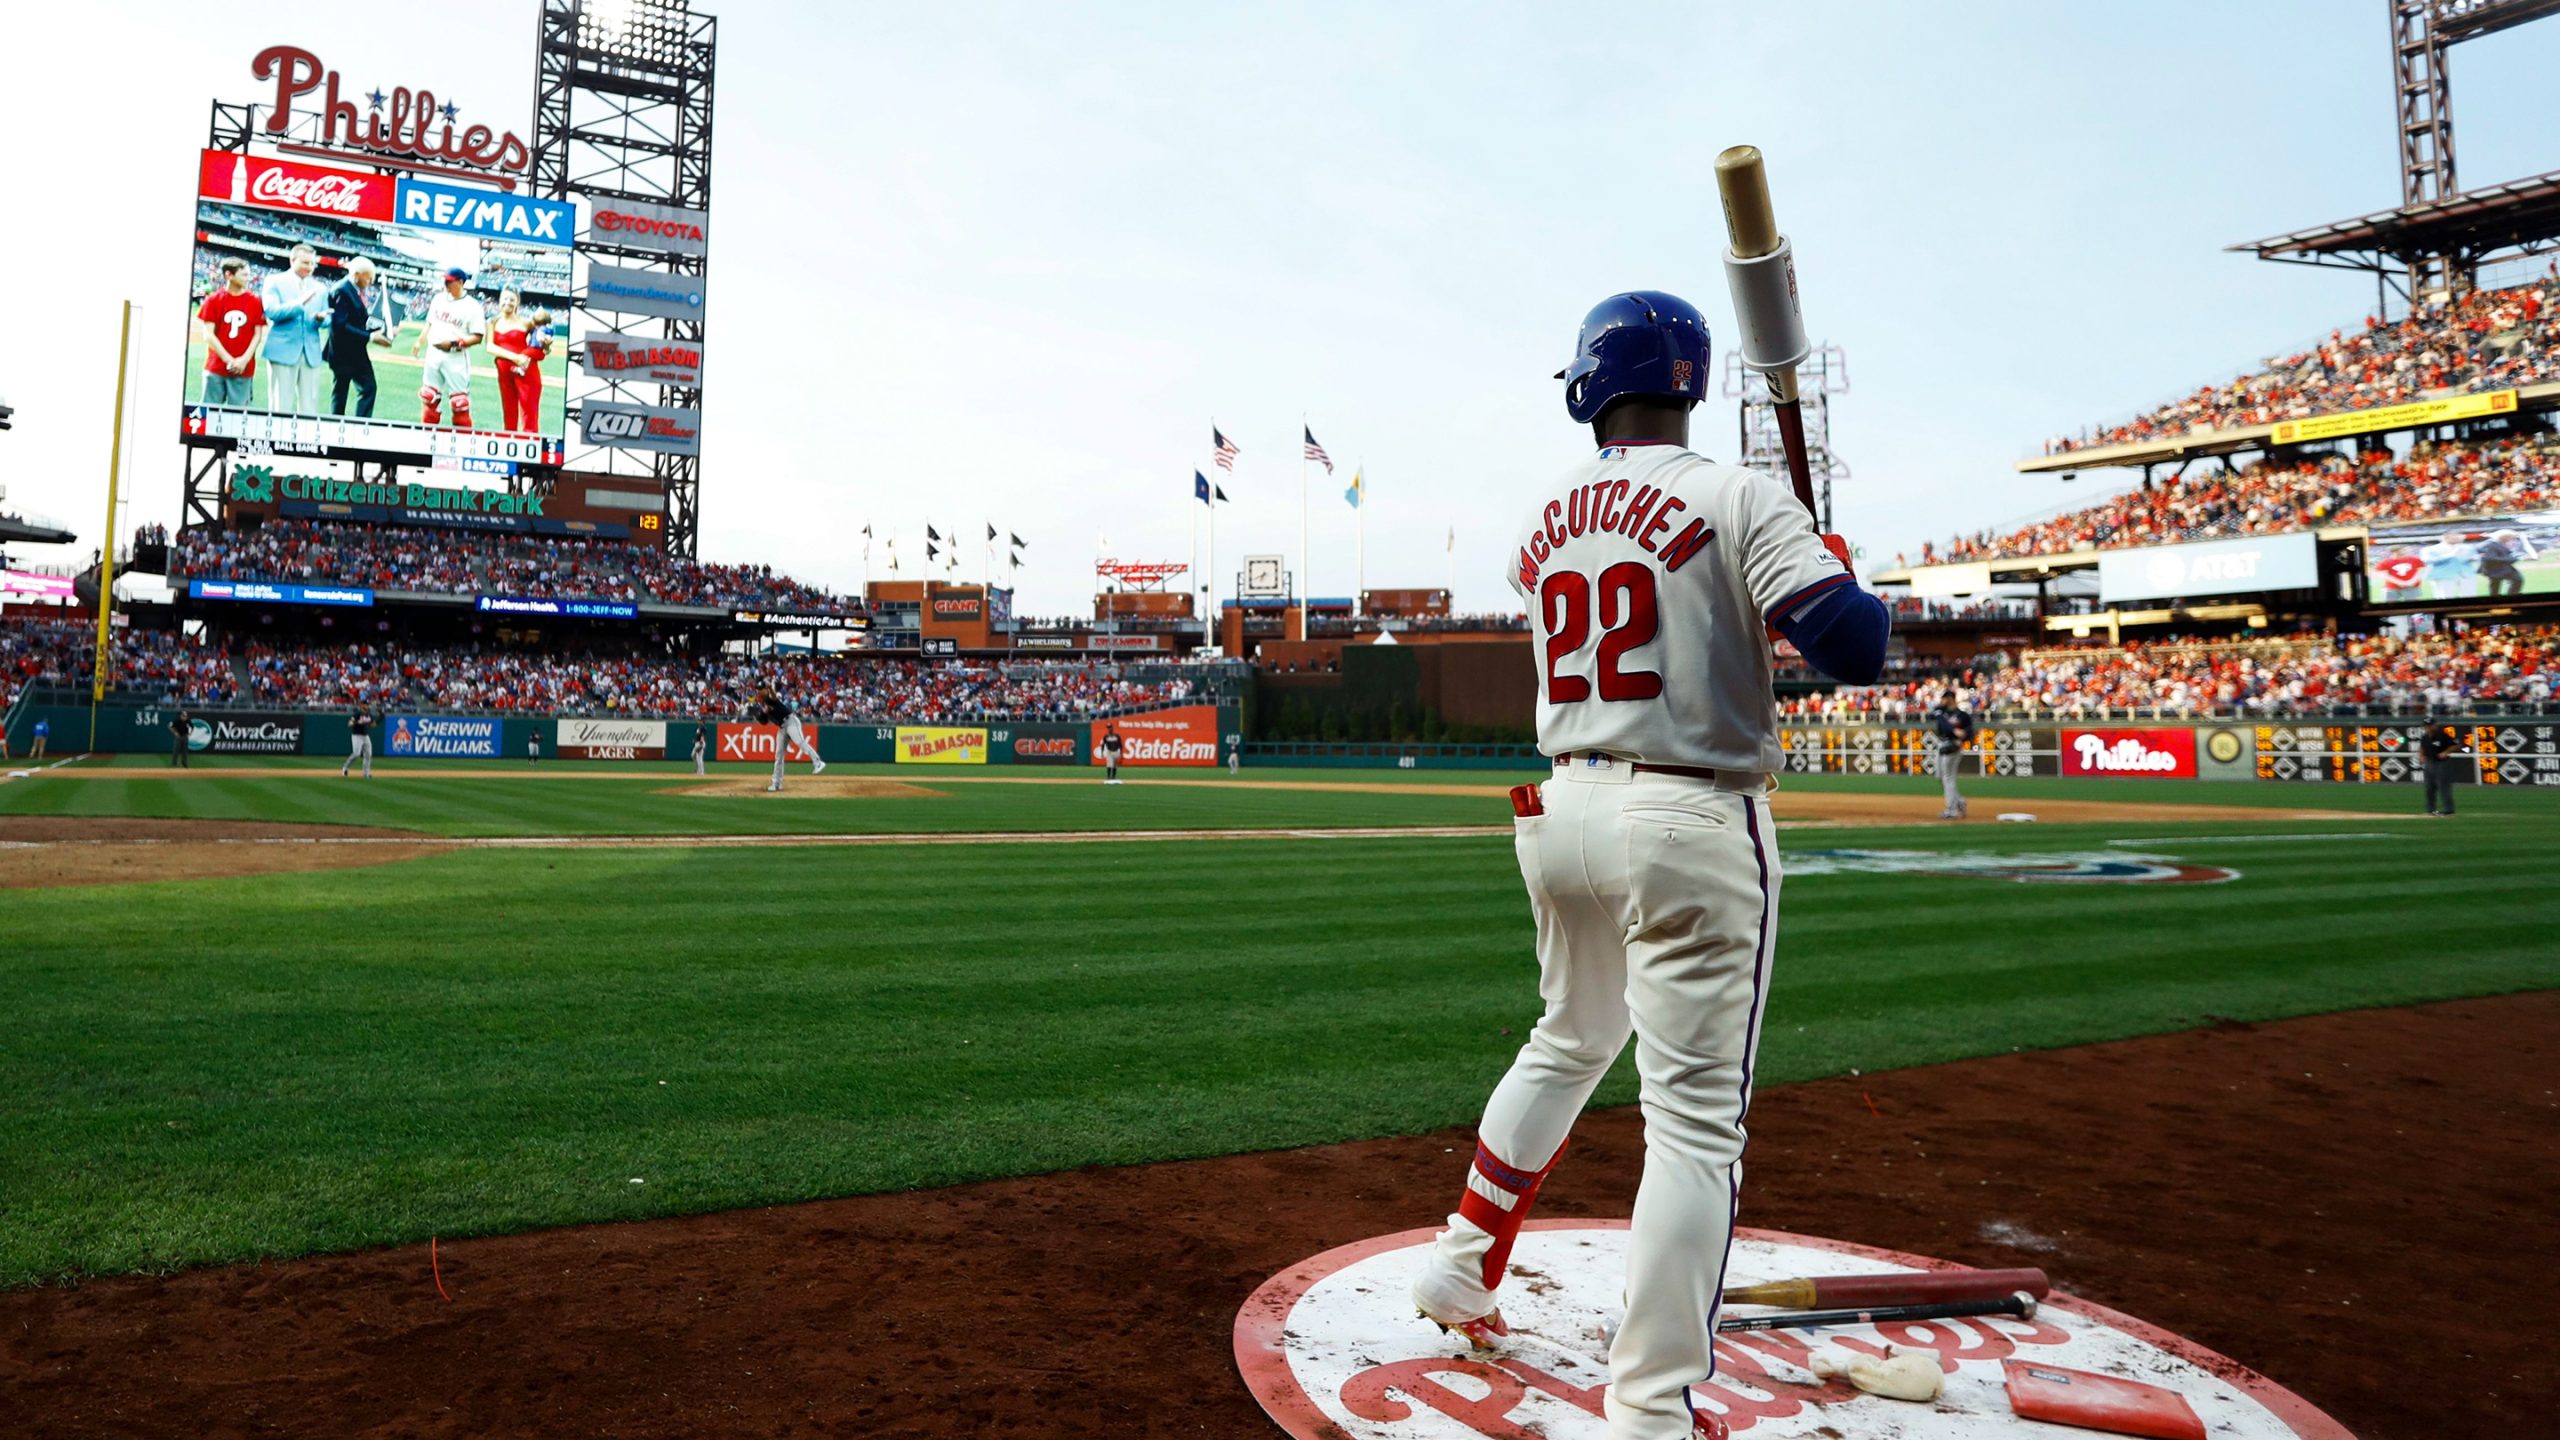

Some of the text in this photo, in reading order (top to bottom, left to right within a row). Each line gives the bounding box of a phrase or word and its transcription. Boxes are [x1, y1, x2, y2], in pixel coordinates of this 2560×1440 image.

[252, 45, 530, 184] Phillies
[252, 167, 368, 213] Coca-Cola
[405, 189, 558, 239] RE/MAX
[622, 214, 703, 242] TOYOTA
[1672, 360, 1693, 380] 22
[487, 440, 499, 456] 0
[506, 442, 518, 458] 0
[525, 444, 537, 460] 0
[281, 474, 544, 516] Citizens Bank Park
[406, 510, 462, 522] HARRY
[2190, 552, 2261, 582] AT&T
[492, 600, 529, 611] Jefferson
[566, 605, 632, 616] 1-800-JEFF-NOW
[935, 600, 978, 613] GIANT
[763, 614, 841, 627] #AuthenticFan
[1541, 561, 1663, 704] 22
[215, 721, 300, 741] NovaCare
[416, 718, 492, 737] SHERWIN
[571, 722, 651, 743] Yuengling
[877, 729, 893, 740] 374
[215, 741, 295, 750] REHABILITATION
[588, 746, 635, 759] LAGER
[723, 727, 811, 759] xfiny
[1014, 739, 1075, 756] GIANT
[2074, 734, 2177, 770] Phillies
